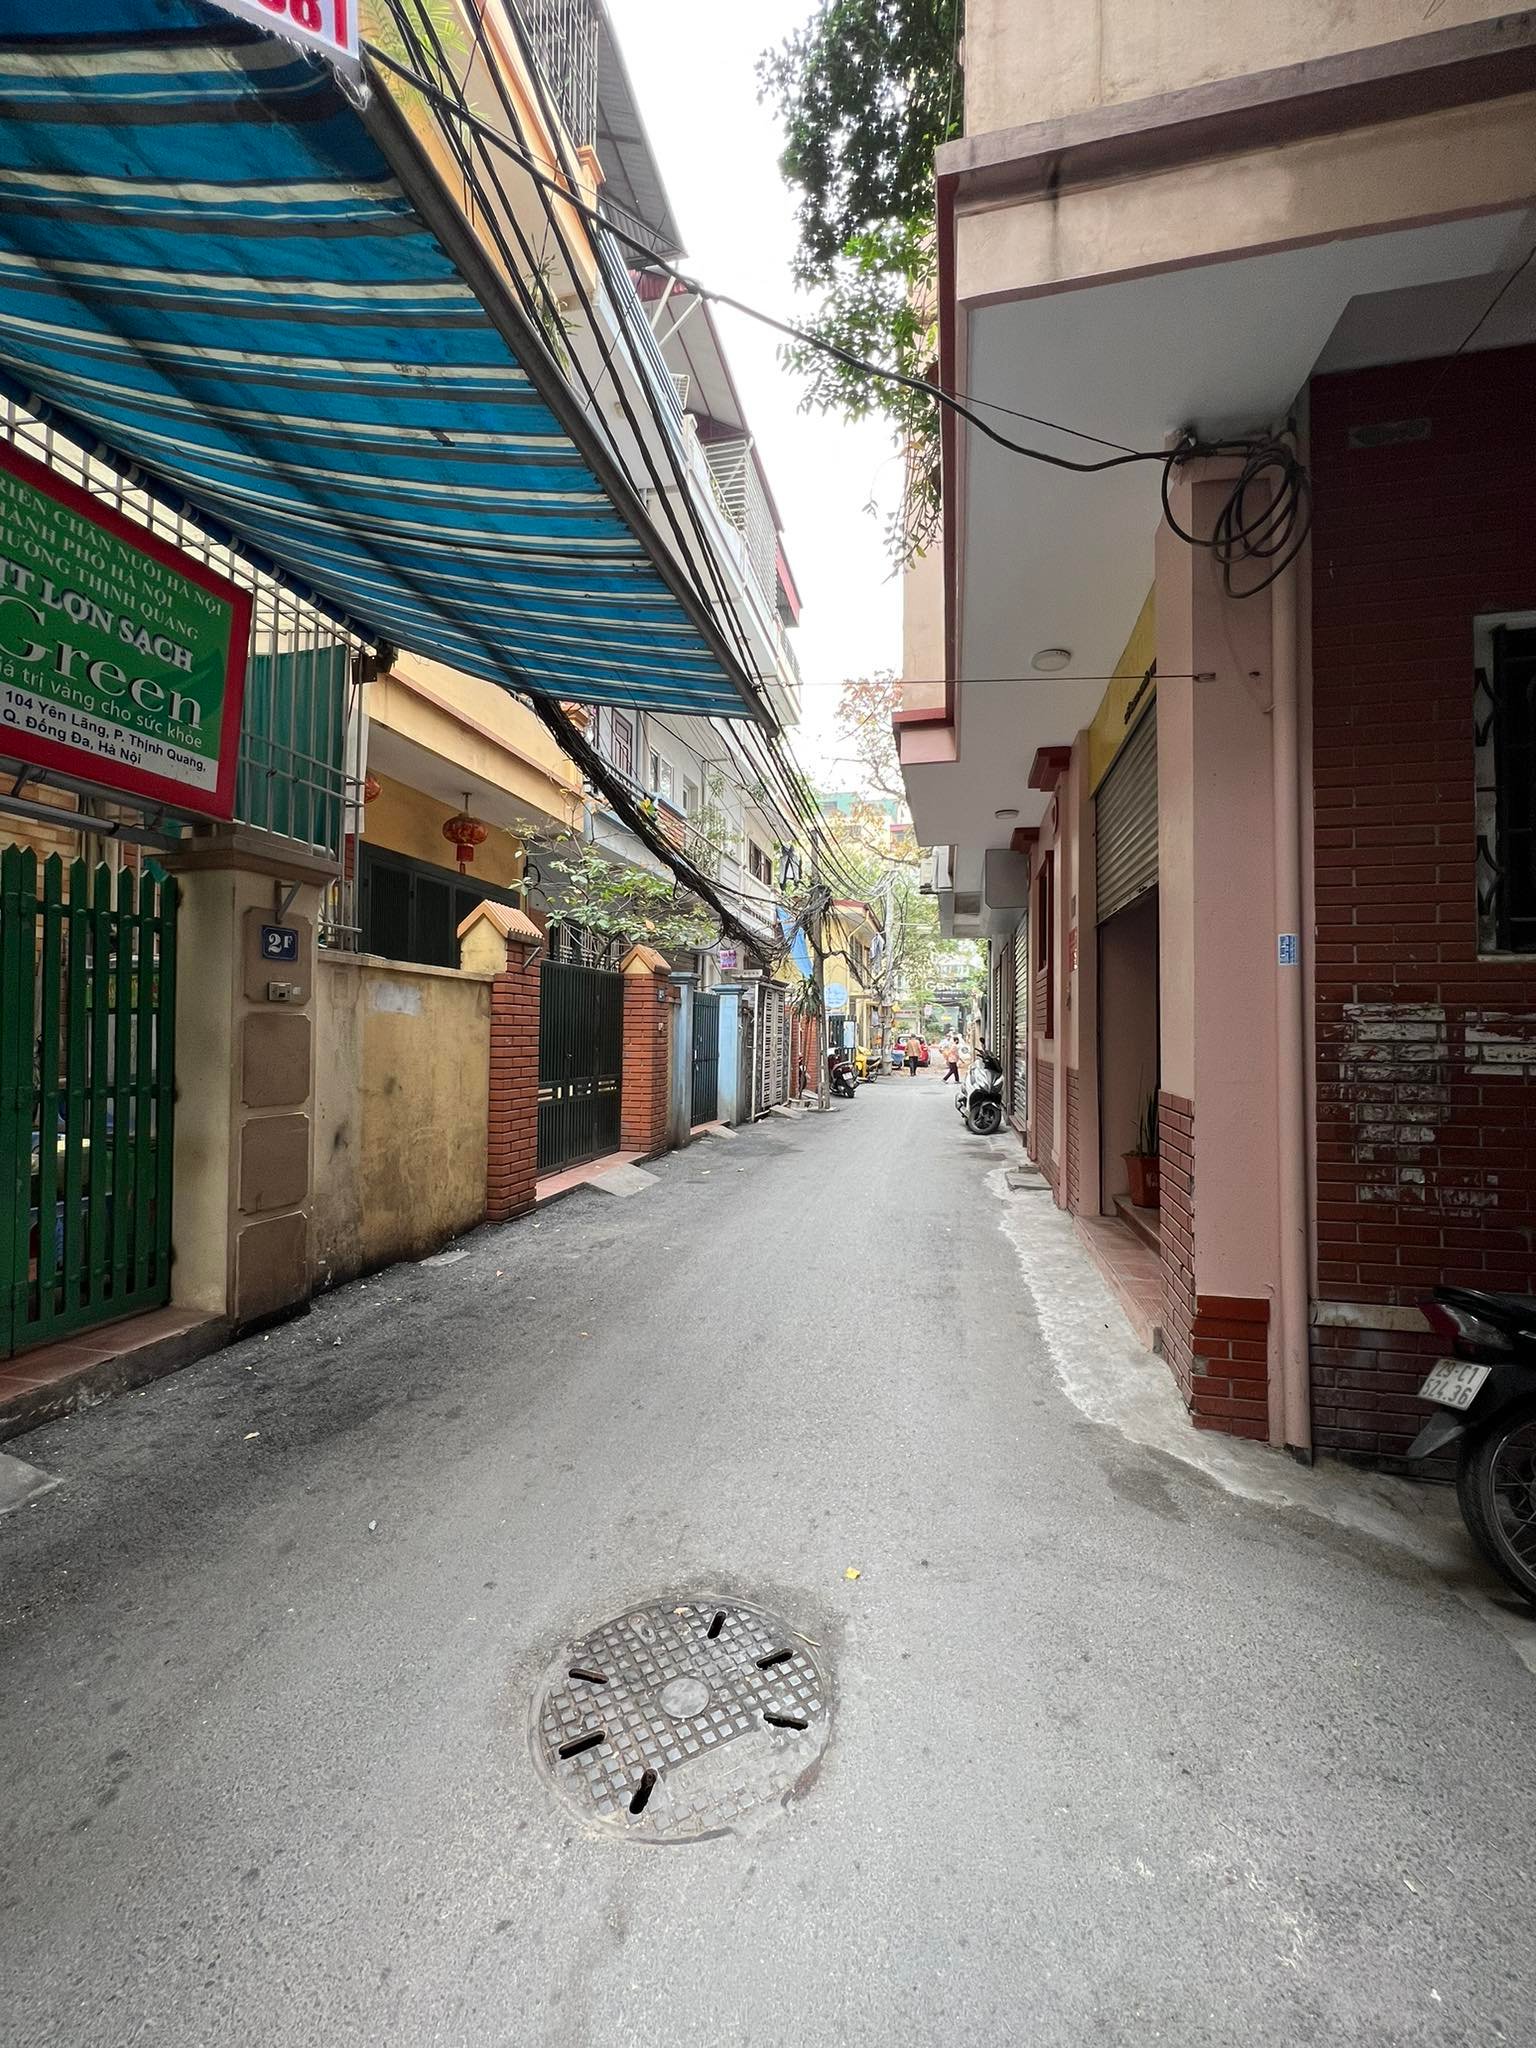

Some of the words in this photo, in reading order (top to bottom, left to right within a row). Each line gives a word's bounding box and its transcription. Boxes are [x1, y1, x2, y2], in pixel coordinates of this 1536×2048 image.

[75, 566, 136, 609] THỊNH
[140, 602, 199, 640] QUANG
[111, 564, 136, 589] HÀ
[118, 546, 161, 582] NUÔI
[167, 575, 190, 598] HÀ
[40, 578, 115, 635] LỢN
[119, 616, 194, 673] SẠCH
[0, 594, 203, 731] Green
[5, 690, 34, 710] 104
[38, 700, 67, 722] Yên
[71, 713, 110, 739] Lãng,
[113, 728, 125, 743] P.
[129, 733, 164, 756] Thịnh
[166, 748, 207, 773] Quang,
[22, 667, 44, 692] trị
[50, 676, 95, 712] vàng
[101, 700, 131, 721] cho
[136, 714, 163, 733] sức
[3, 708, 21, 725] Q.
[70, 731, 94, 750] Đa,
[98, 740, 116, 756] Hà
[120, 748, 142, 765] Nội
